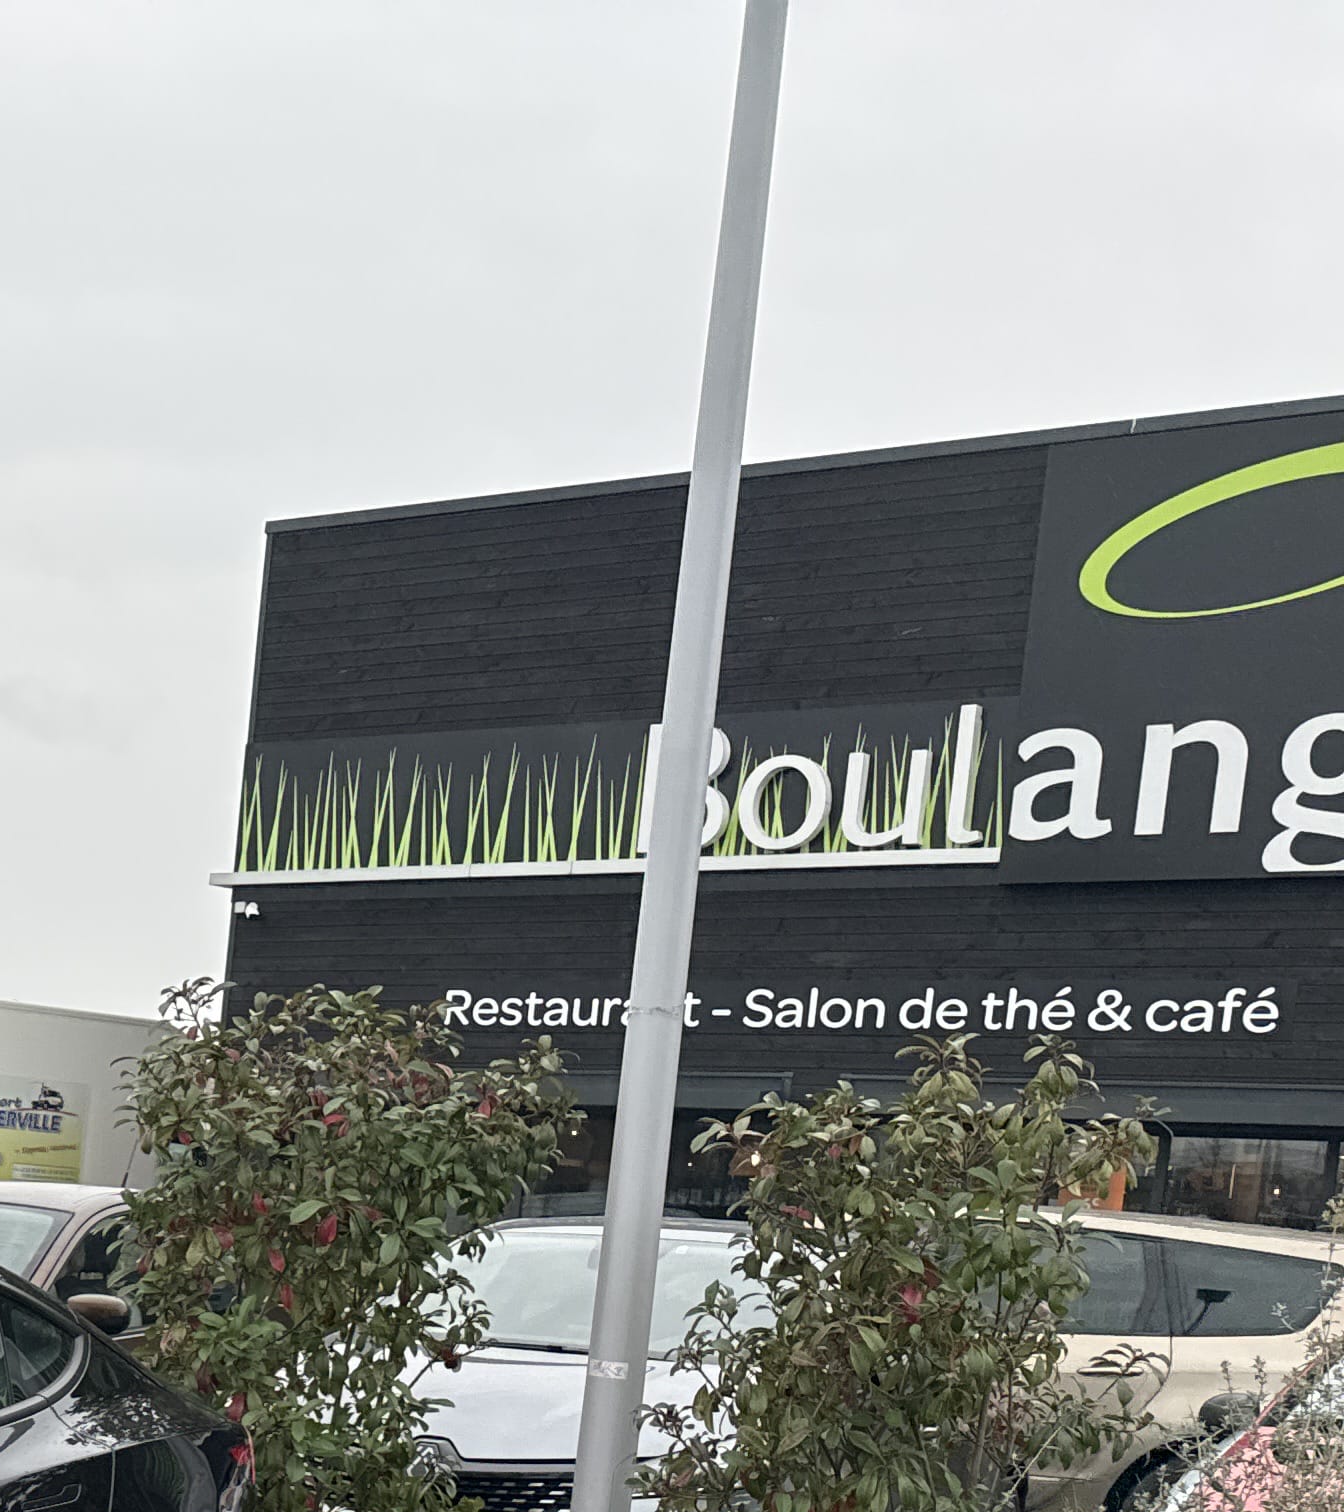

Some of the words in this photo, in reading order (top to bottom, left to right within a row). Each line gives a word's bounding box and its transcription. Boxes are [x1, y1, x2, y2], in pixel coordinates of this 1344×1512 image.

[444, 989, 701, 1028] Restaurt
[742, 987, 886, 1029] Salon
[898, 987, 968, 1030] de
[981, 986, 1076, 1031] thé
[1087, 989, 1132, 1031] &
[1145, 986, 1279, 1033] café
